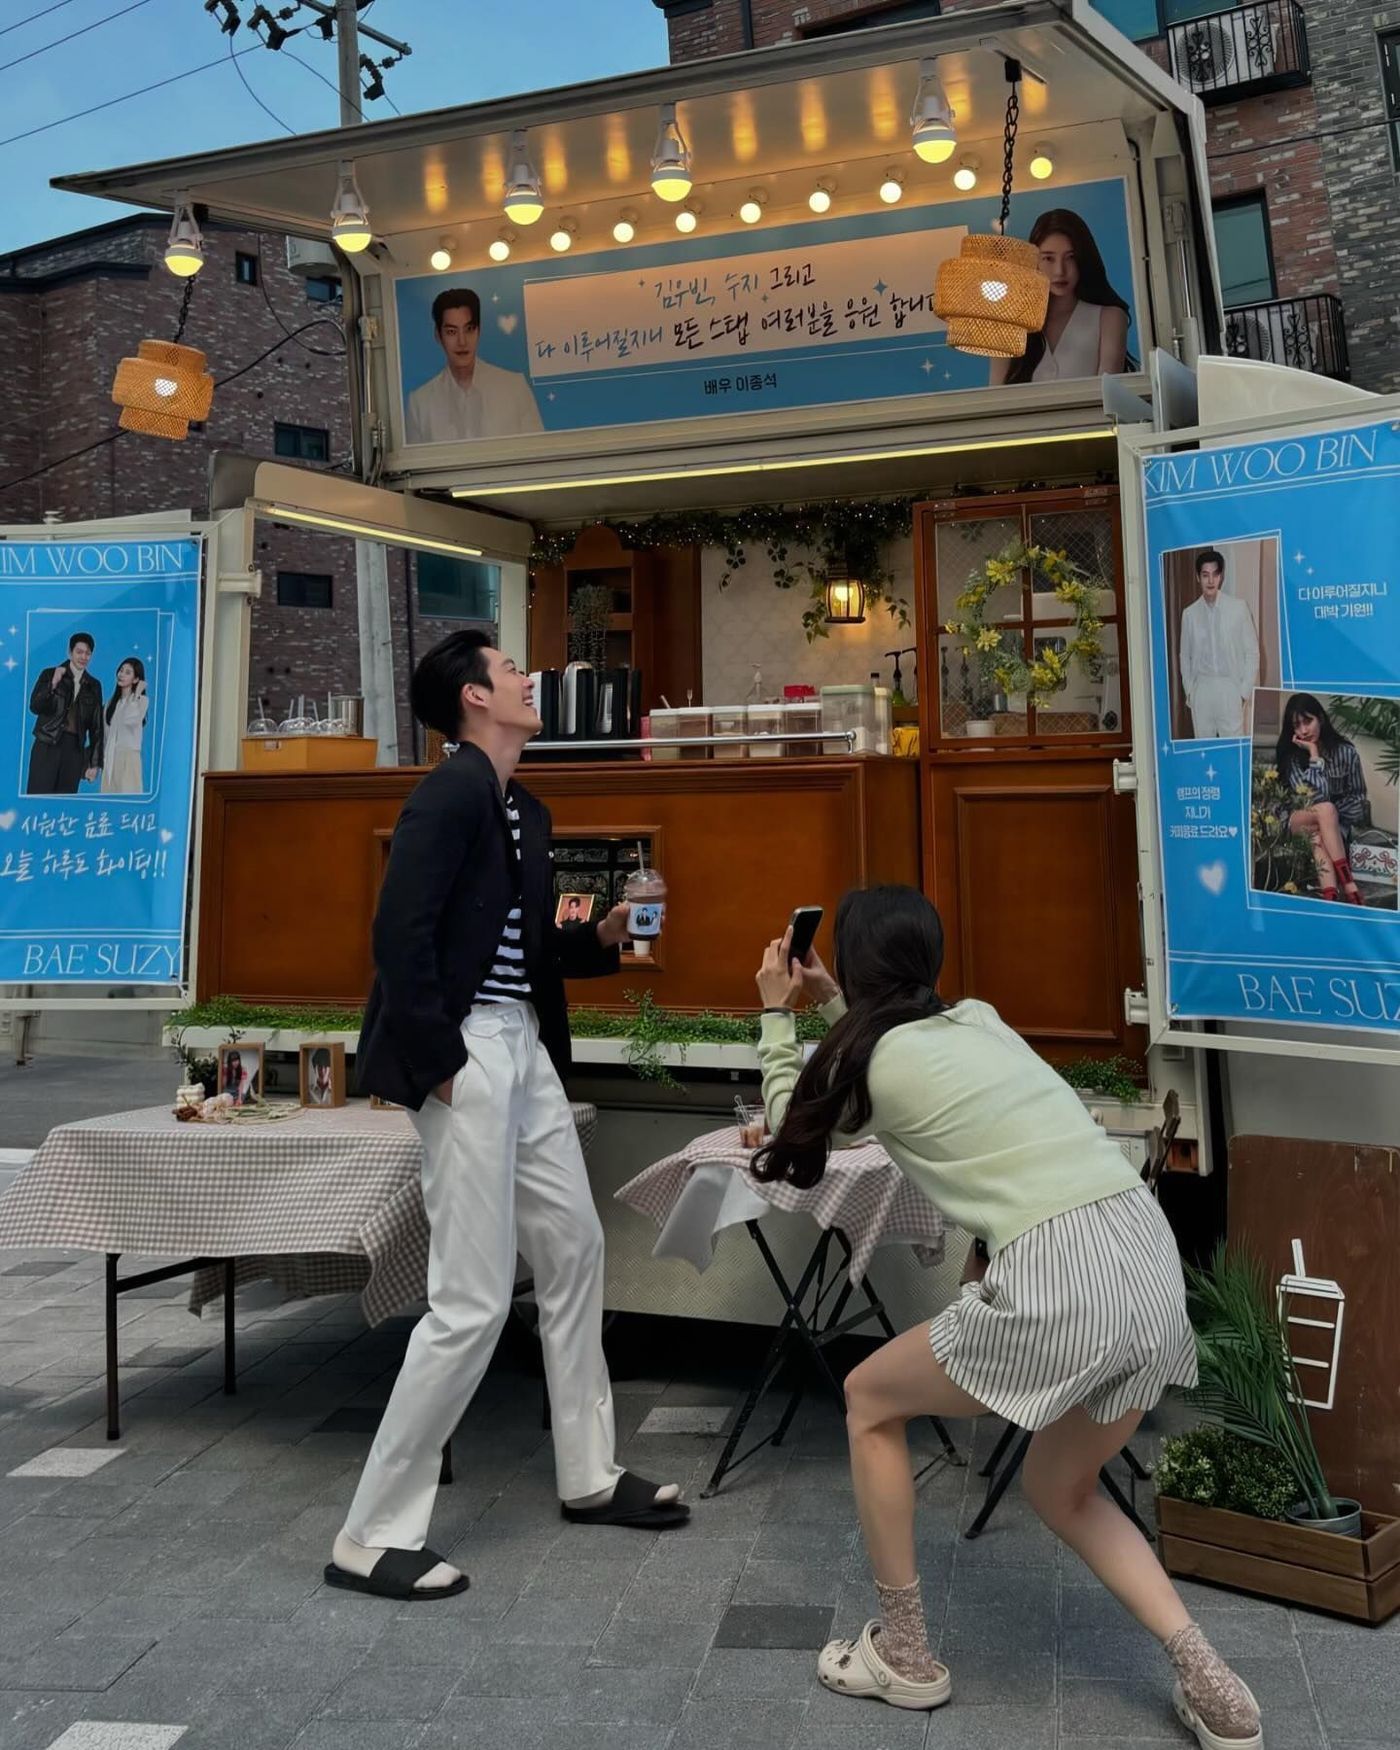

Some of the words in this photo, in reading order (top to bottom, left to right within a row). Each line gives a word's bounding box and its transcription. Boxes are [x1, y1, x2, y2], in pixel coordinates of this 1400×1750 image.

[655, 277, 716, 309] 김우빈,
[725, 273, 758, 301] 수지
[770, 263, 816, 290] 그리고
[536, 340, 556, 358] 다
[674, 316, 704, 350] 모든
[709, 312, 750, 346] 스탭
[761, 300, 838, 338] 여러분을
[844, 296, 881, 330] 응원
[704, 376, 732, 395] 배우
[736, 373, 777, 392] 이종석
[1211, 442, 1306, 486] WOO
[1316, 429, 1378, 471] BIN
[0, 547, 37, 574] IM
[46, 545, 128, 574] WOO
[138, 543, 183, 573] BIN
[1314, 605, 1338, 619] 대박
[1341, 602, 1374, 617] 기원!!
[22, 812, 78, 838] 시원한
[85, 811, 114, 839] 음료
[120, 813, 157, 835] 드시고
[0, 850, 34, 882] 오늘
[42, 849, 89, 881] 하루도
[96, 848, 167, 880] 화이팅!!
[23, 944, 89, 975] BAE
[94, 943, 181, 977] SUZY
[1237, 973, 1322, 1015] BAE
